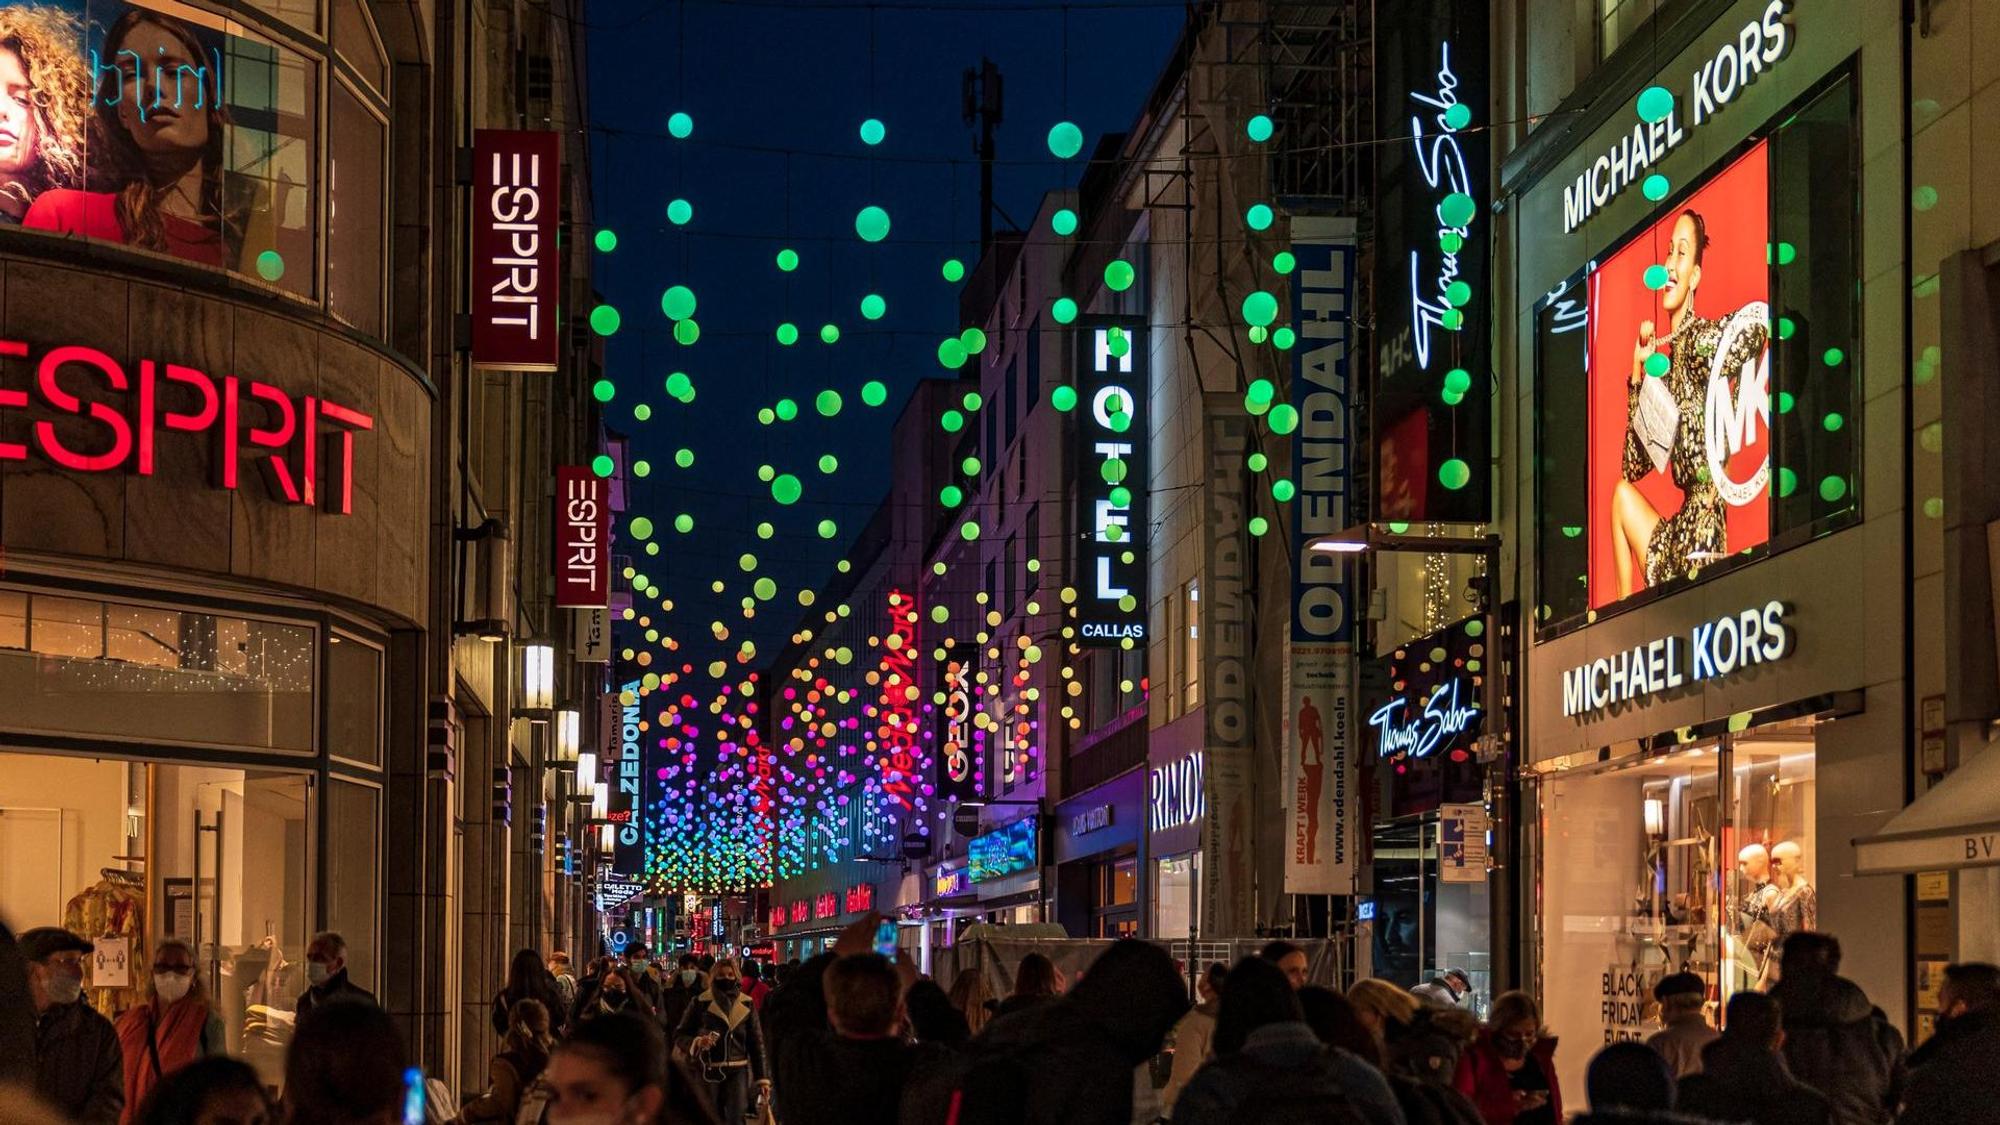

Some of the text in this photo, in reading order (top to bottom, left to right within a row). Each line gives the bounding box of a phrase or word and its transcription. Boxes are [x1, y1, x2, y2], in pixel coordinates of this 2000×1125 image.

[1563, 0, 1787, 234] MICHAEL KORS
[491, 152, 540, 339] ESPRIT
[1093, 328, 1134, 600] HOTEL
[1300, 249, 1345, 636] ODENDAHL
[567, 479, 598, 592] ESPRIT
[1082, 624, 1143, 638] CALLAS
[1563, 600, 1787, 716] MICHAEL KORS
[947, 661, 969, 782] GEOX
[1369, 698, 1418, 757] Thomas
[1417, 676, 1477, 757] Sabo
[1334, 697, 1346, 865] www.odendahl.koeln
[1296, 822, 1306, 865] KRAFT
[1602, 973, 1644, 997] BLACK
[1602, 1001, 1644, 1026] FRIDAY
